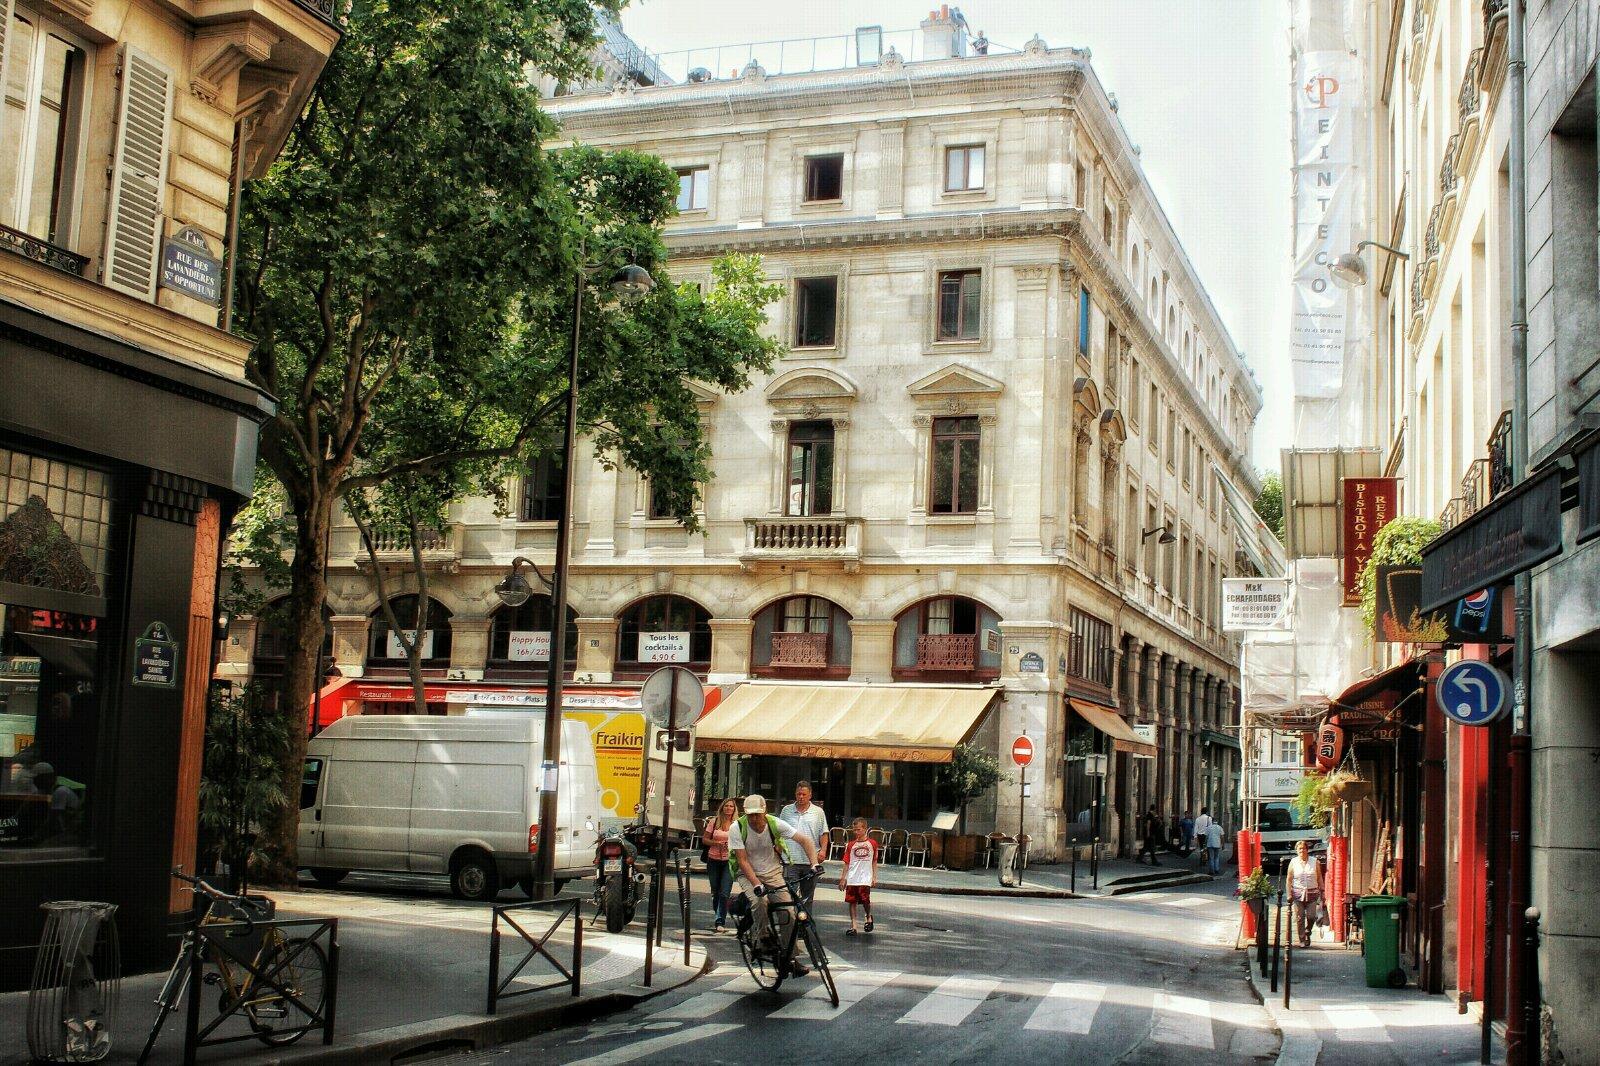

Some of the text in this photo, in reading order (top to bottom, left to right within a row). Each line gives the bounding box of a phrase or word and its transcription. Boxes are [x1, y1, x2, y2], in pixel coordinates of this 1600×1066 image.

[1311, 76, 1340, 294] PEINTECO
[176, 251, 209, 272] RUE DES
[168, 260, 215, 286] LAVANDIÈRES
[174, 275, 216, 299] OPPORTUNE
[1354, 484, 1366, 539] BISTROT
[1354, 543, 1366, 551] A
[1245, 584, 1262, 592] M&K
[1226, 595, 1281, 603] ECHAFAUDAGES
[1461, 609, 1485, 618] pepsi
[511, 636, 551, 645] Happy Hou
[651, 653, 676, 661] 4,90 €
[359, 691, 392, 699] Restaurant
[596, 732, 643, 745] Fraikin
